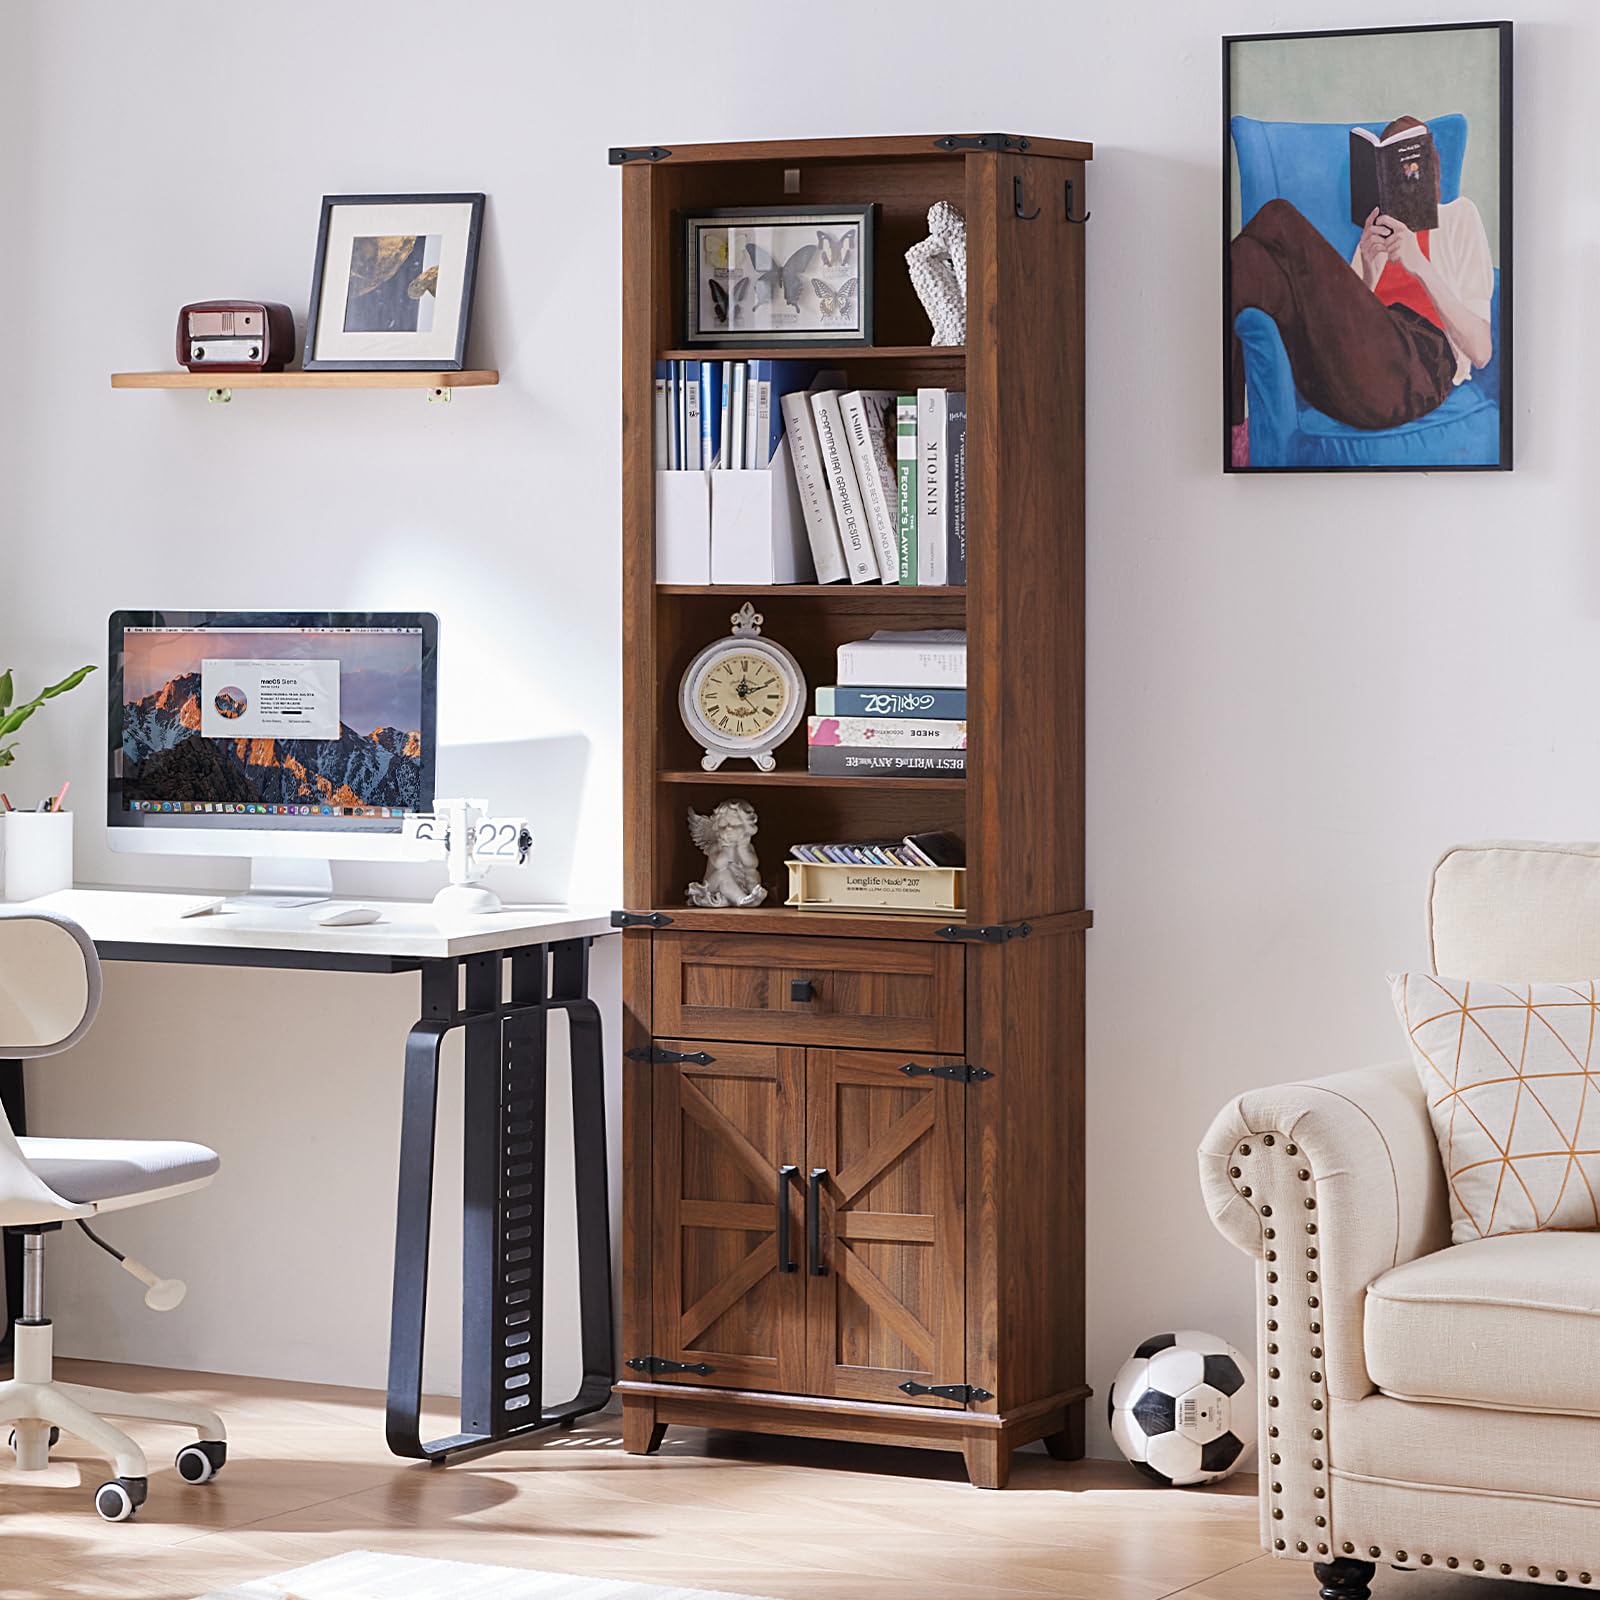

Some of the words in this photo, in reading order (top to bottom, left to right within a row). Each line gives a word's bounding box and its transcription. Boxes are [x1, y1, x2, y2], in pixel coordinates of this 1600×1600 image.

[850, 407, 866, 447] FASHION
[927, 441, 938, 516] KINFOLK
[901, 467, 909, 525] PEOPLE'S
[835, 476, 853, 516] GRAPHIC
[846, 516, 862, 551] DESIGN
[880, 531, 890, 549] AND
[901, 527, 909, 578] LAWYER
[884, 550, 895, 571] BAGS
[910, 729, 940, 737] SHEDE
[936, 759, 964, 769] BEST
[476, 824, 517, 855] 22
[846, 876, 880, 887] Longlife
[907, 878, 920, 887] 207
